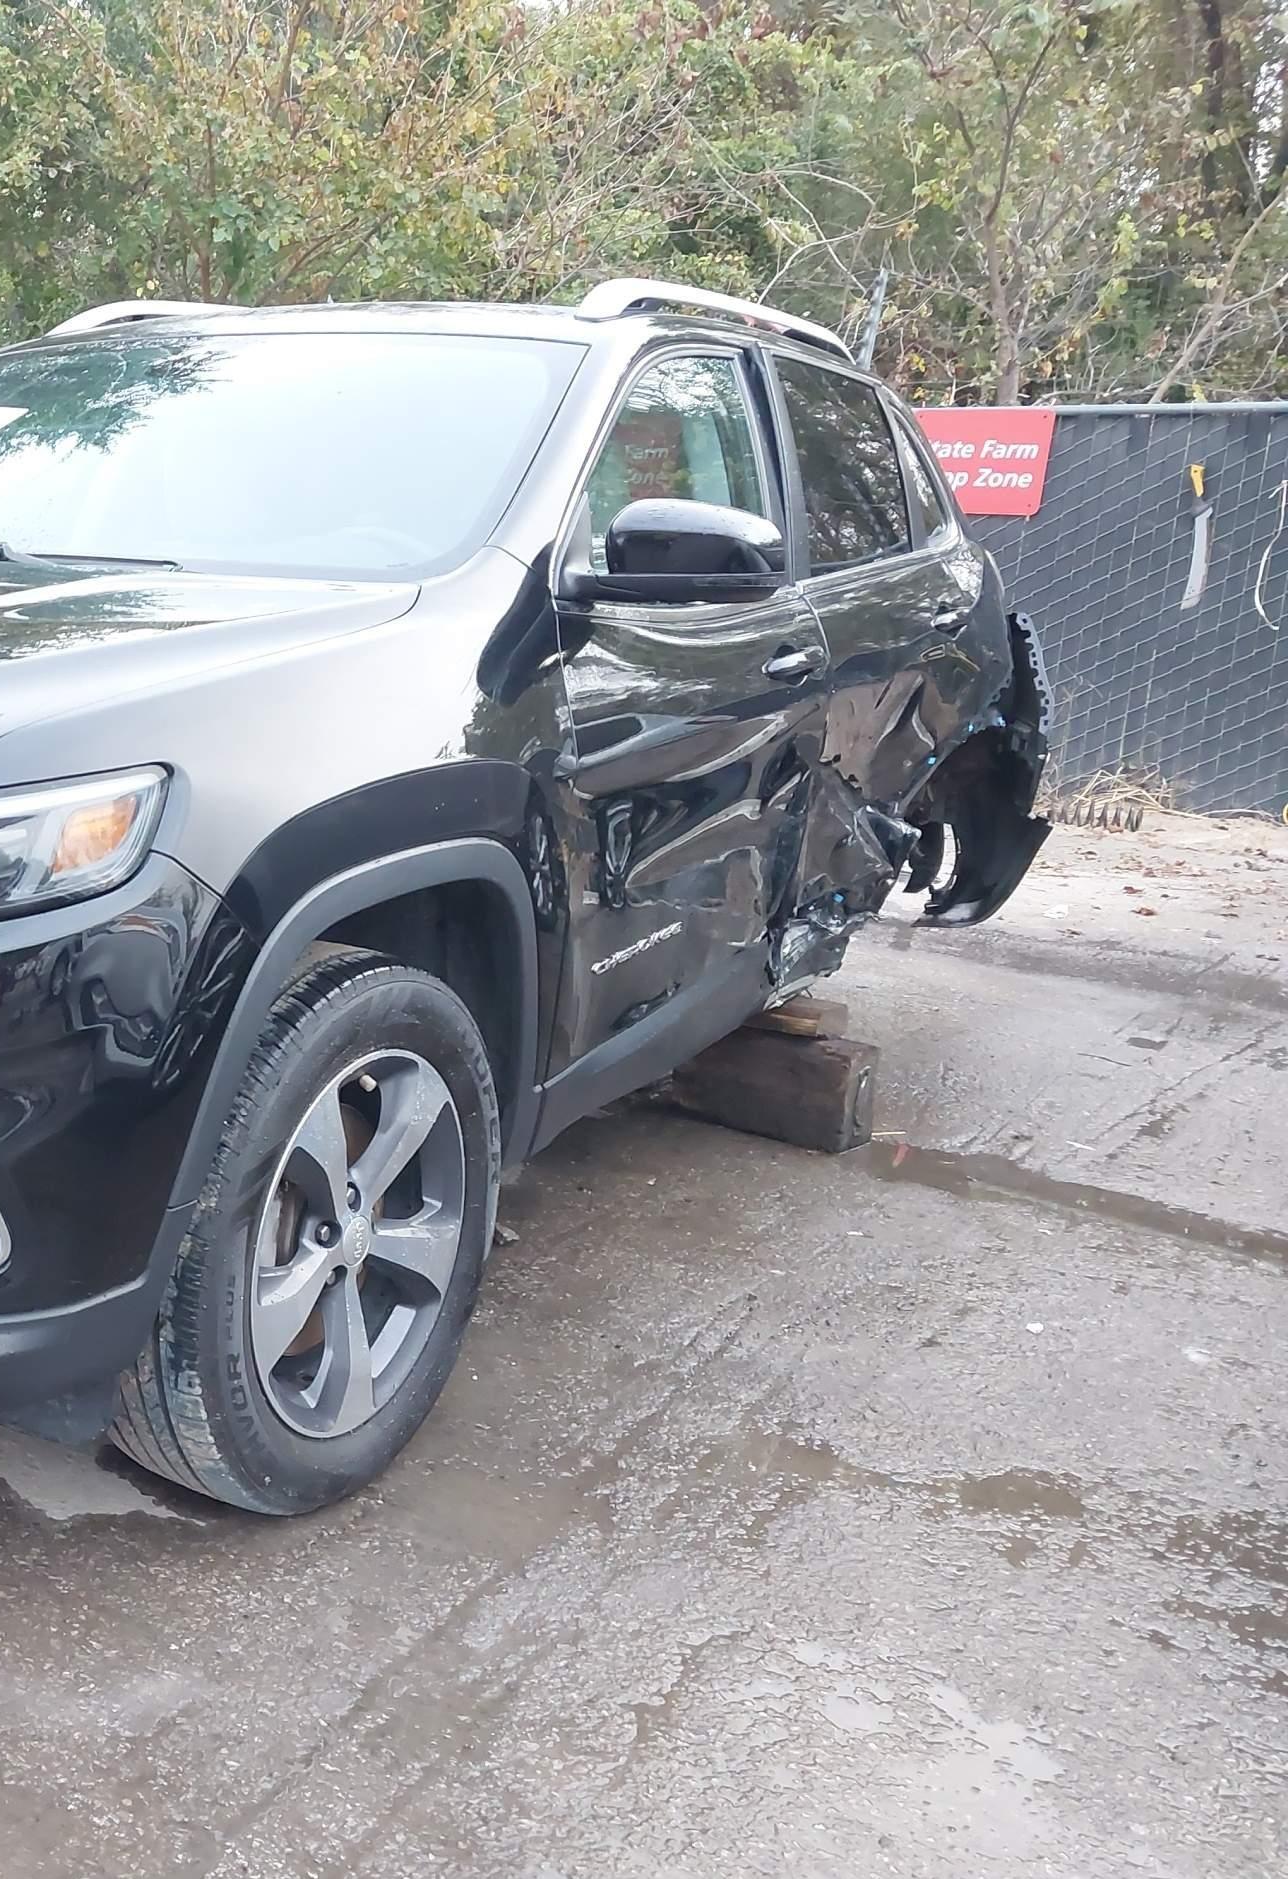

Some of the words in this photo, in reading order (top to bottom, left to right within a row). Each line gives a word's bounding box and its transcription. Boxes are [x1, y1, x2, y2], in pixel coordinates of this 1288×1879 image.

[928, 439, 976, 459] tate
[979, 439, 1039, 460] Farm
[972, 467, 1033, 489] Zone
